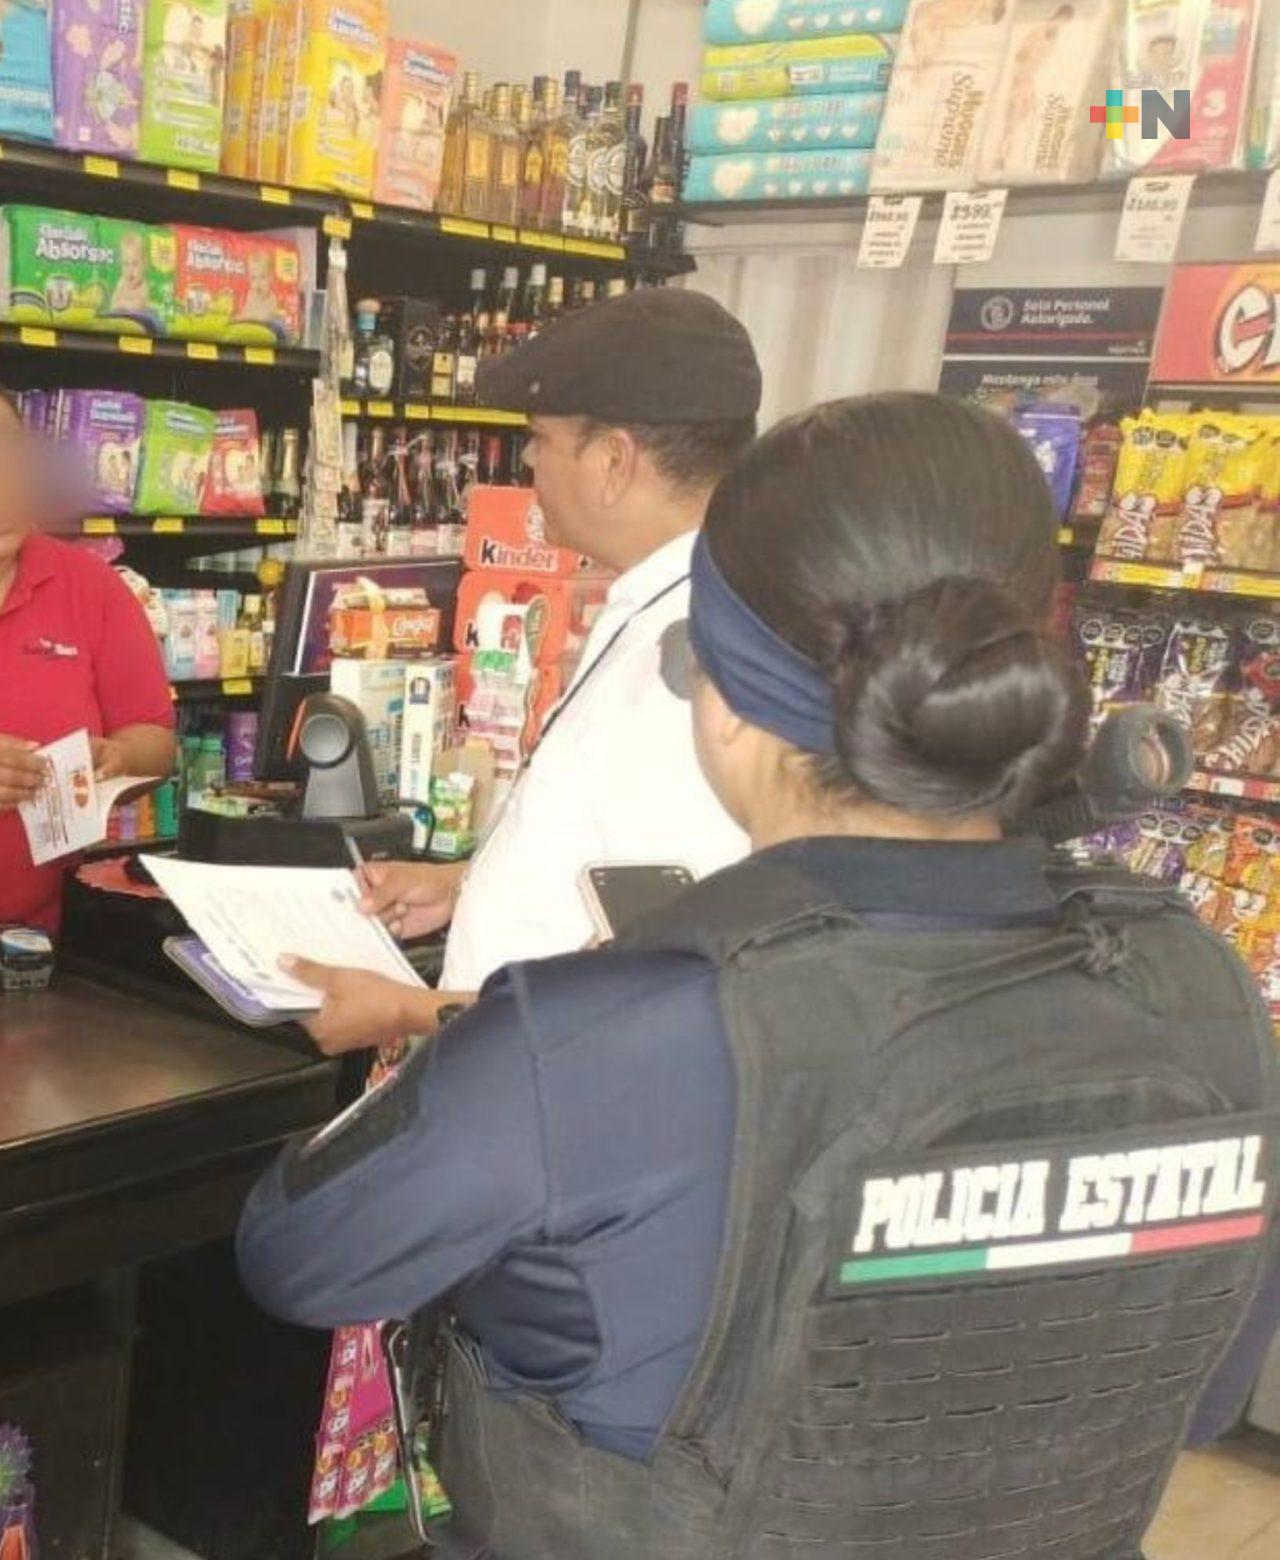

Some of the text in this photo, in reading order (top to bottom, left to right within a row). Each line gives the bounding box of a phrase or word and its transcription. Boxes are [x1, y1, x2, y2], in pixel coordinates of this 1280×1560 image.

[1054, 298, 1110, 311] Personal
[852, 1135, 1266, 1253] POLICIA ESTATAL
